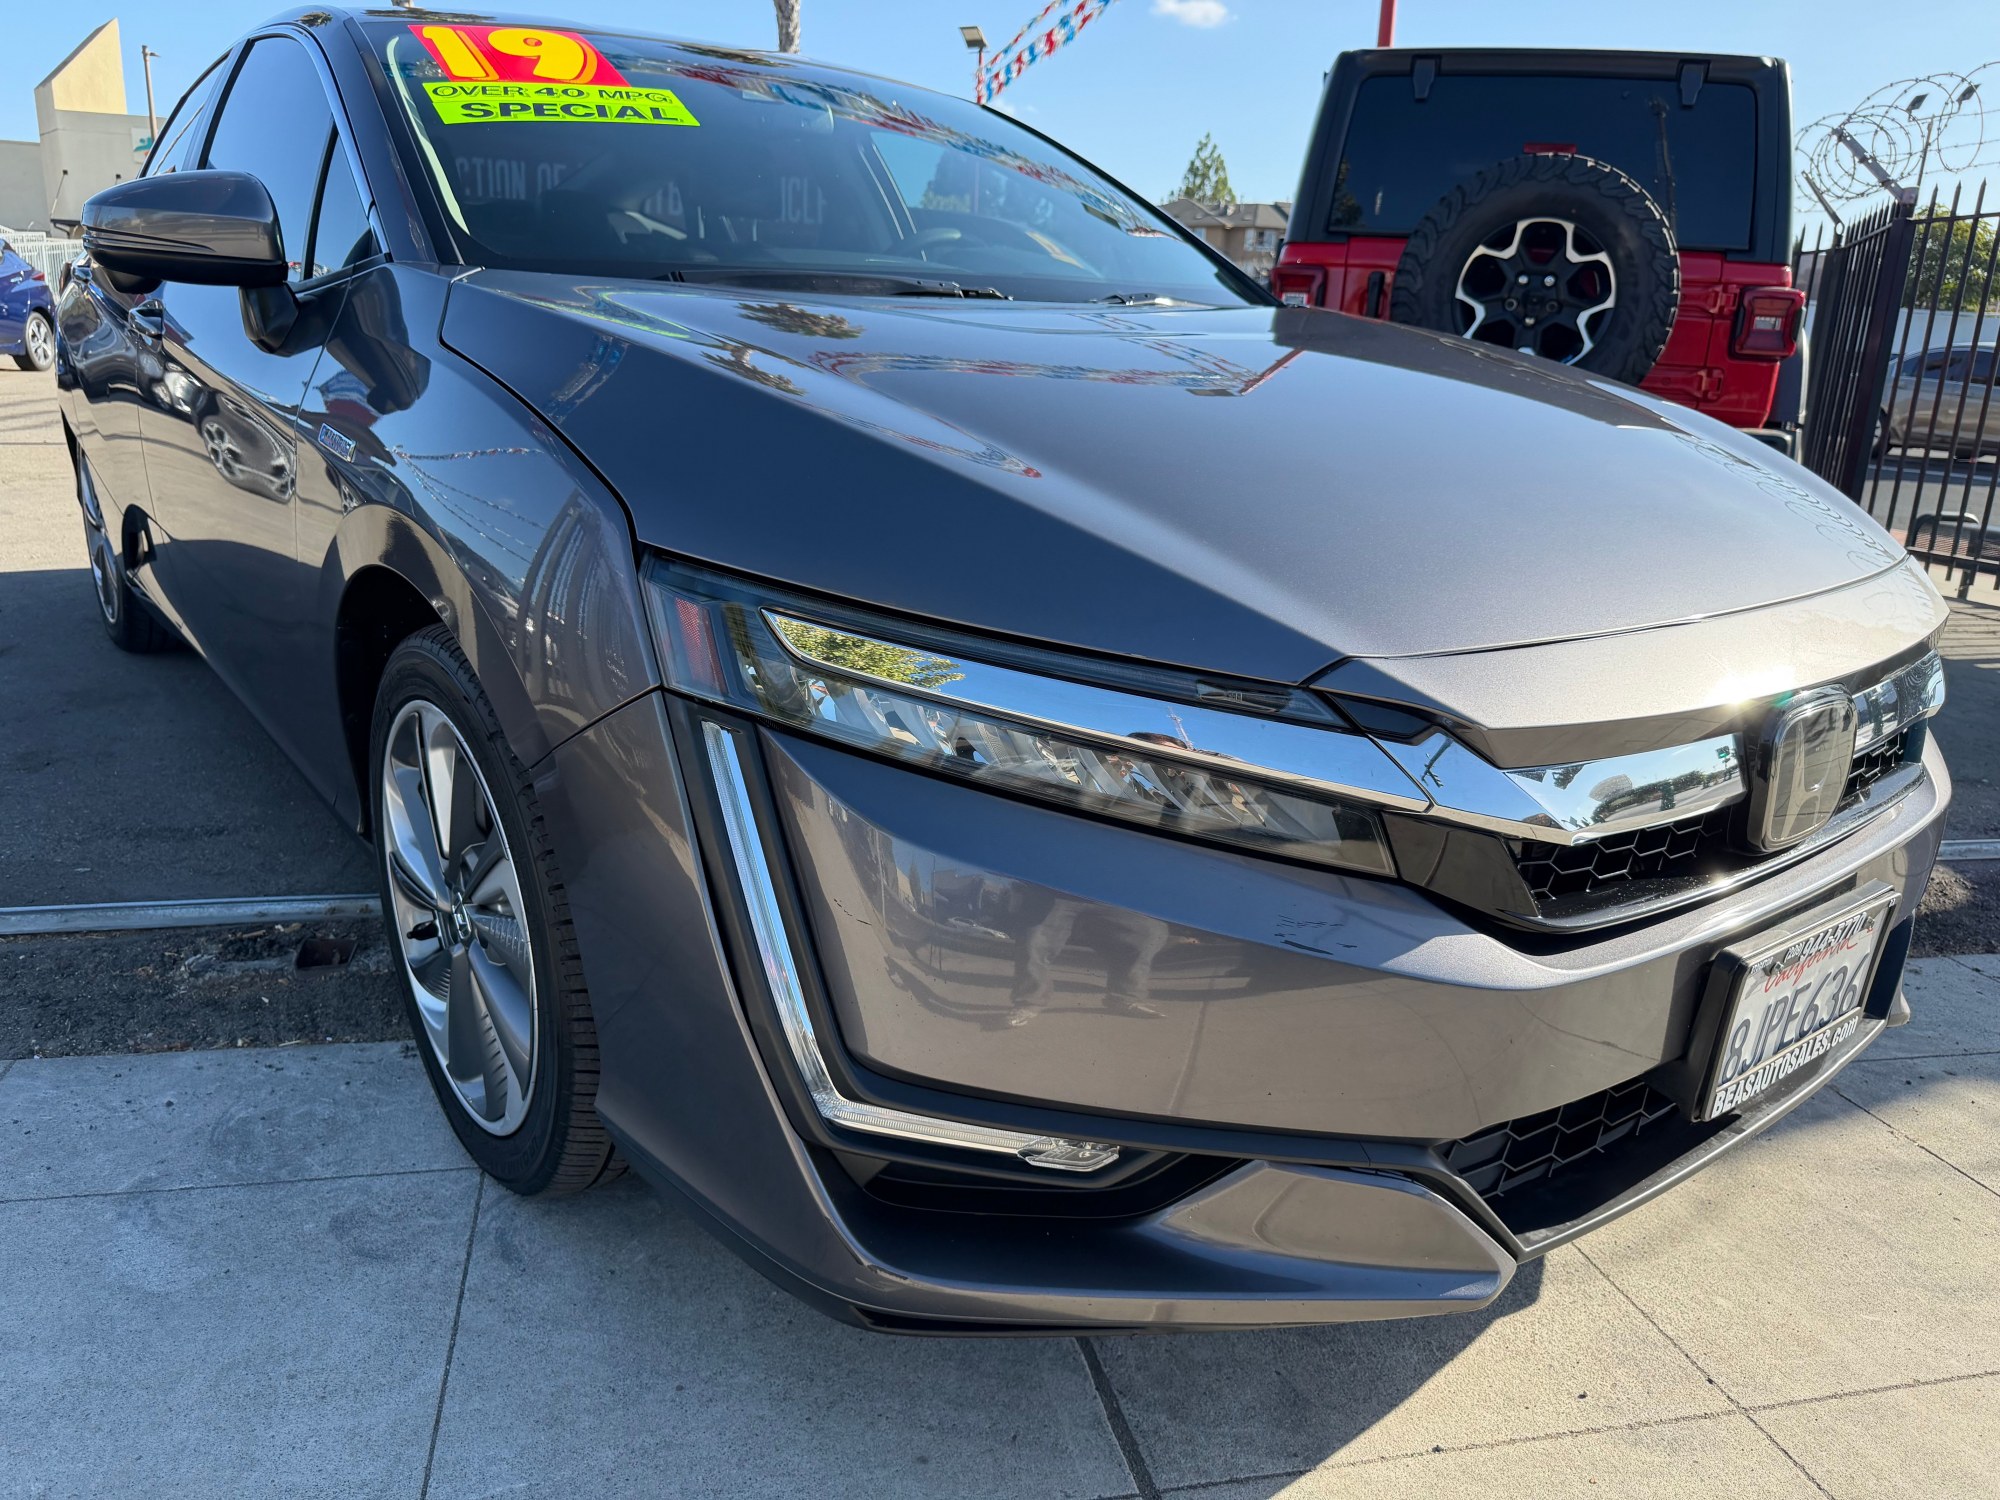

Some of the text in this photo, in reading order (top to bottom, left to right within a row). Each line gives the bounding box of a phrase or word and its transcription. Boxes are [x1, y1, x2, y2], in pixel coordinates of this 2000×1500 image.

[422, 26, 598, 84] 19
[432, 85, 674, 104] OVER 40 MPG
[460, 102, 684, 122] SPECIAL
[1721, 953, 1870, 1085] 8JPE636
[1710, 1015, 1859, 1119] BEASAUTOSALES.com
